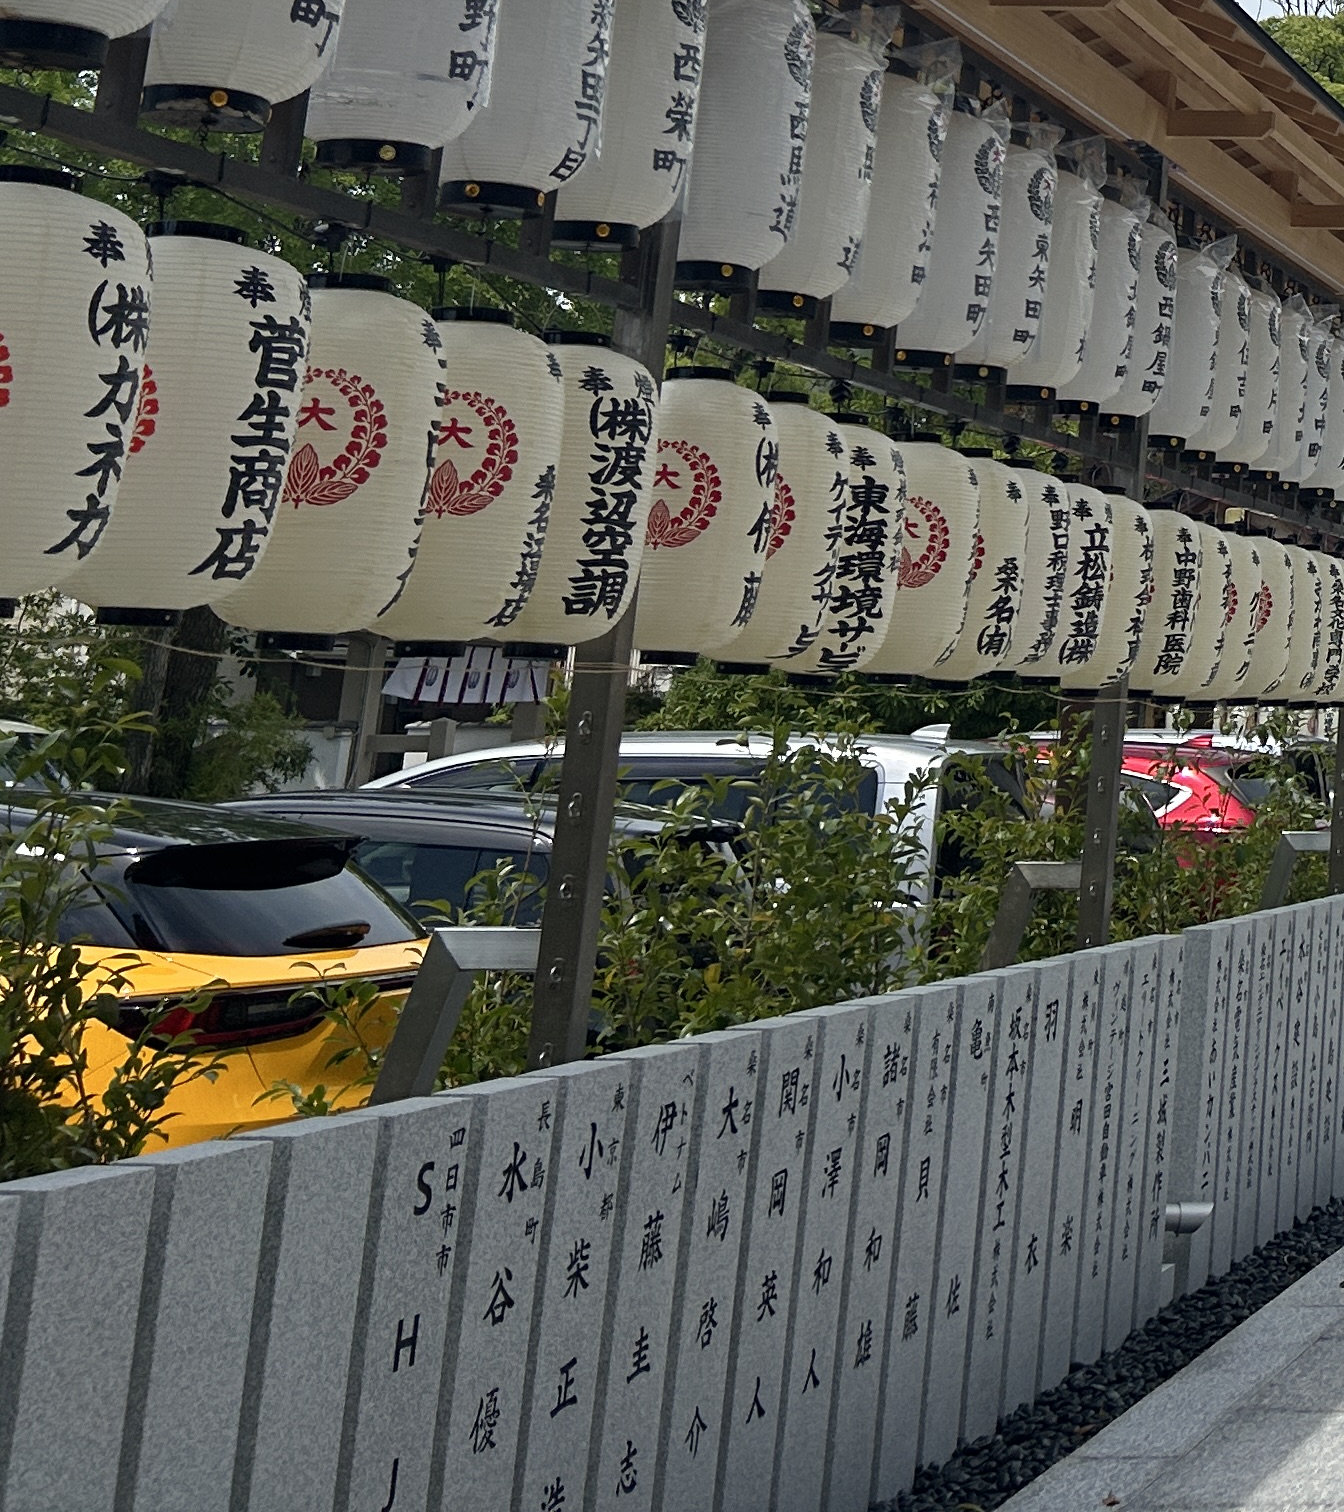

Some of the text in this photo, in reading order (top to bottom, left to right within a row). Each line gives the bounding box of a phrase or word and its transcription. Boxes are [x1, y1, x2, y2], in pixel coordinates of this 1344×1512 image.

[83, 220, 126, 269] 奉
[233, 265, 276, 309] 奉
[43, 279, 150, 561] (株カネカ
[188, 315, 305, 582] 菅生商店
[577, 365, 615, 397] 奉
[561, 396, 653, 621] (株)渡辺空調
[1057, 521, 1110, 666] 立松鋳造(株
[1152, 547, 1198, 676] 中野歯科医院
[736, 1048, 759, 1176] 桑名市
[793, 1034, 815, 1150] 桑名市
[846, 1022, 867, 1138] 桑名市
[894, 1010, 913, 1120] 桑名市
[922, 1027, 943, 1137] 有限会社
[939, 1001, 956, 1107] 桑名市
[434, 1125, 467, 1277] 四日市市
[524, 1100, 551, 1245] 長島町
[599, 1083, 625, 1222] 東京都
[671, 1069, 695, 1195] ベトナム
[1023, 998, 1060, 1275] 羽衣
[683, 1085, 740, 1459] 大嶋啓介
[745, 1066, 802, 1425] 関岡英人
[801, 1053, 851, 1395] 小澤和人
[852, 1044, 901, 1372] 諸岡和雄
[469, 1141, 529, 1456] 水谷優
[614, 1099, 678, 1498] 伊藤圭志
